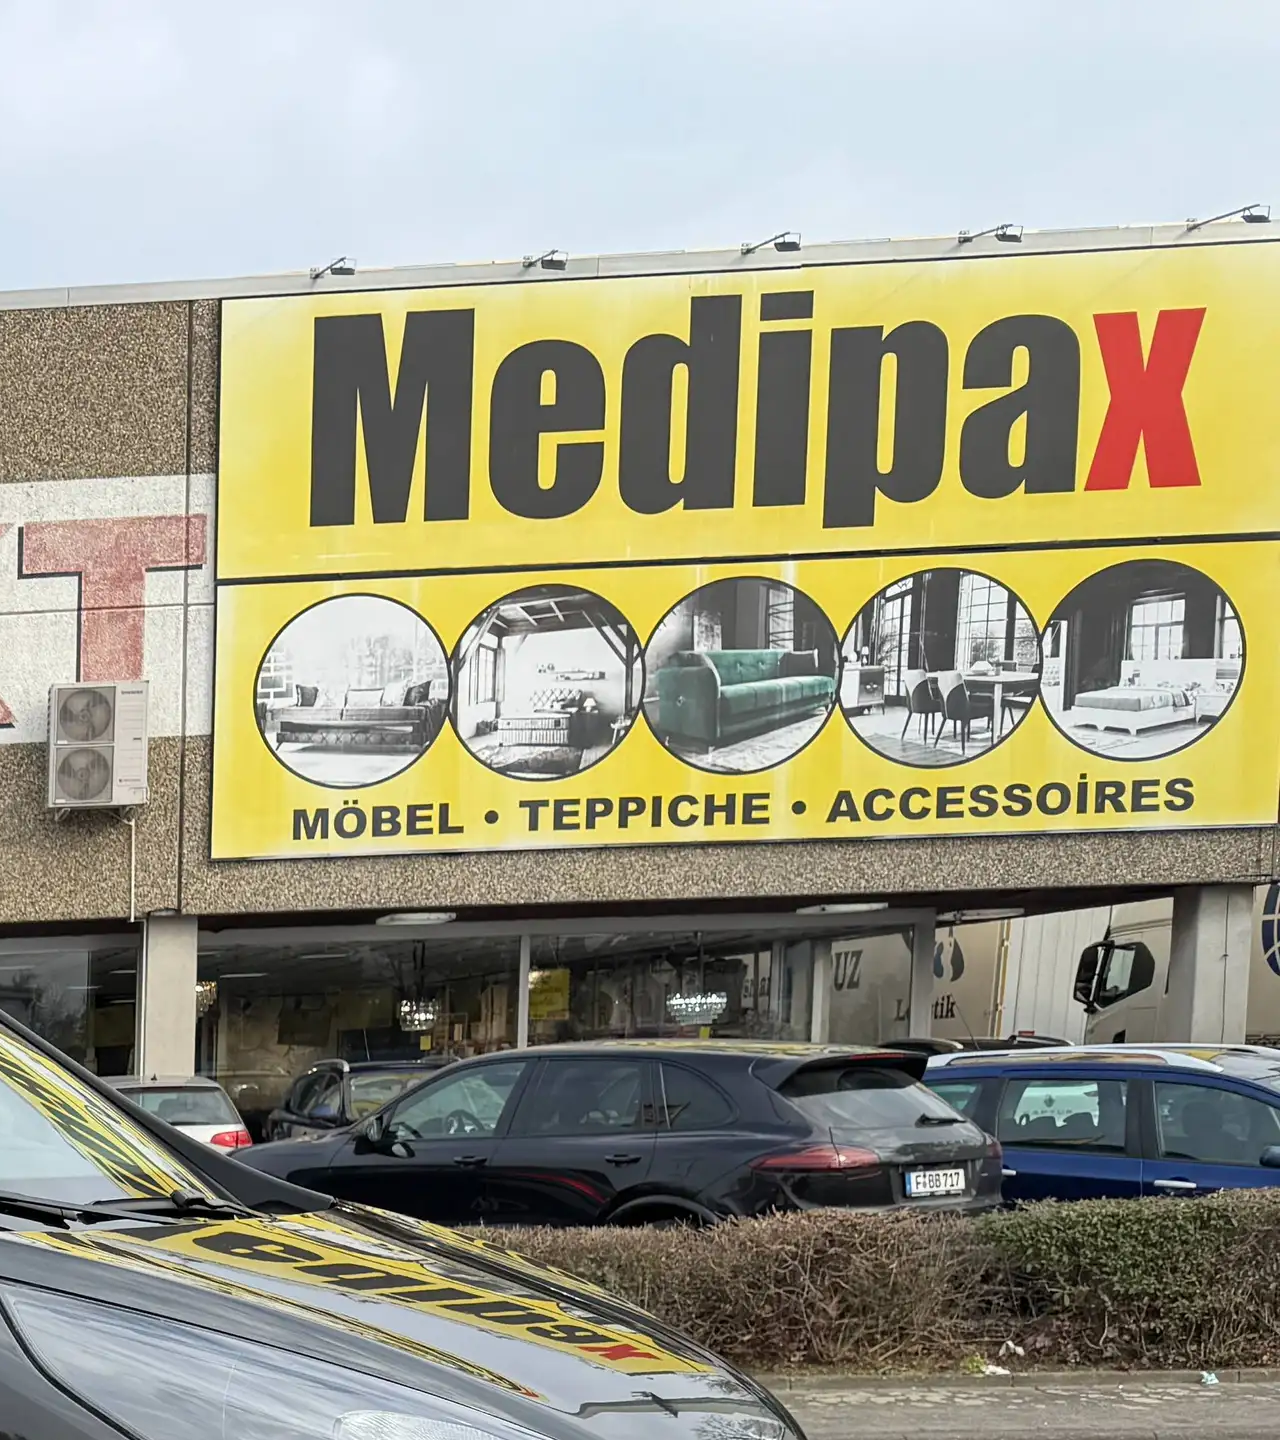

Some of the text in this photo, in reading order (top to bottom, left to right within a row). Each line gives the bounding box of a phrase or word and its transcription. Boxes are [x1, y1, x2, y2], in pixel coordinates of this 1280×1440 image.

[310, 289, 1207, 530] Medipax
[291, 796, 464, 842] MÖBEL
[518, 791, 771, 833] TEPPICHE
